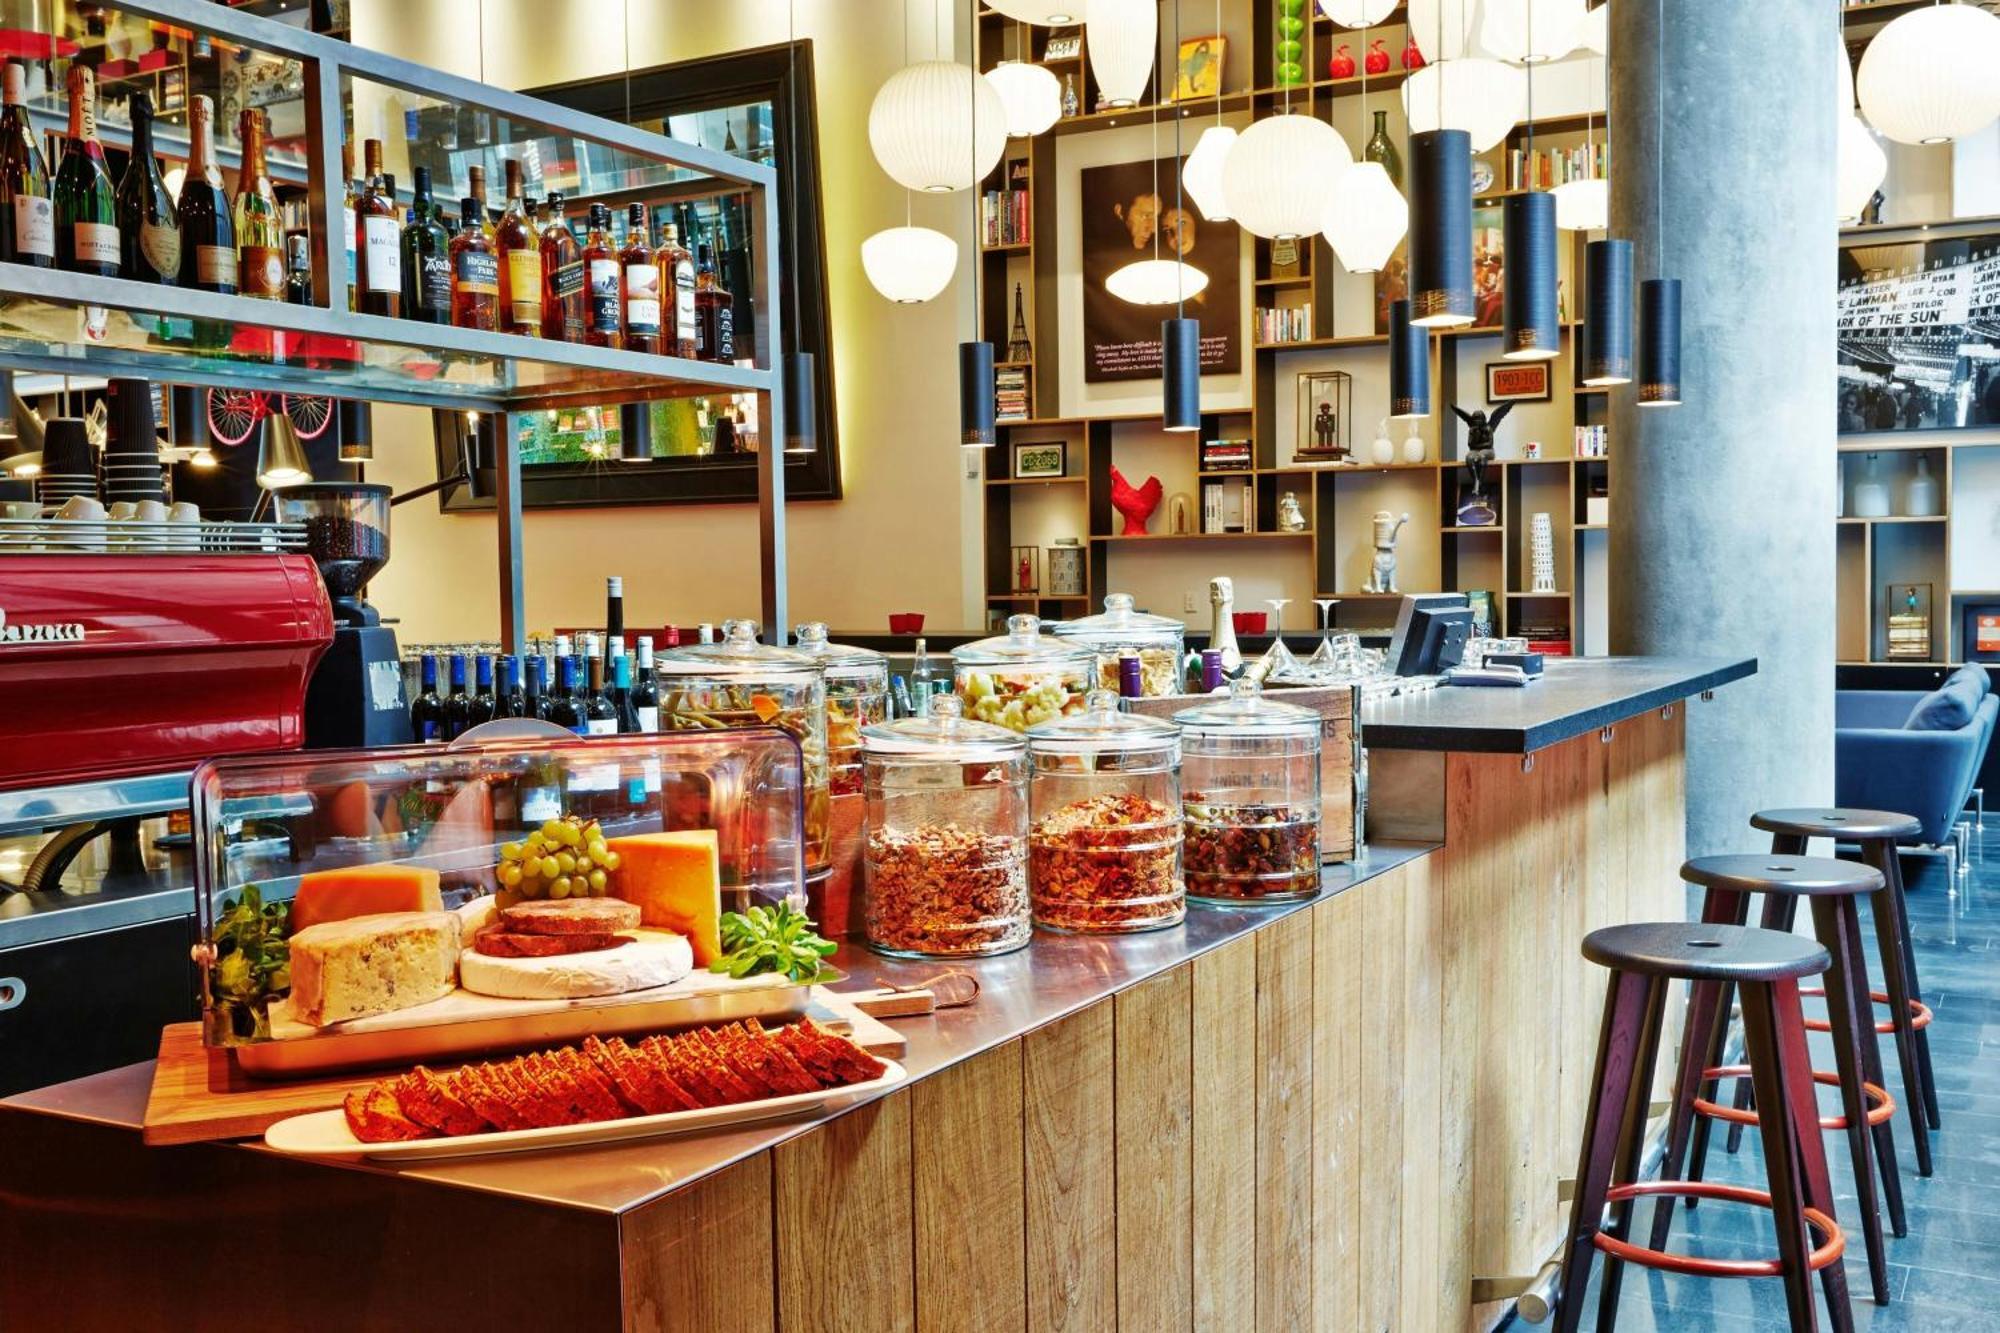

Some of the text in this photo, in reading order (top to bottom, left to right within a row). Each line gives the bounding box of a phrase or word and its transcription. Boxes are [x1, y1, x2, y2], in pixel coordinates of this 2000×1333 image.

[1931, 273, 1956, 283] RYAN
[1848, 292, 1898, 308] LAWMAN
[1911, 299, 1944, 309] TAYLOR
[1985, 293, 2000, 304] OF
[1857, 315, 1874, 327] OF
[1878, 313, 1903, 325] THE
[1908, 310, 1941, 324] SUN
